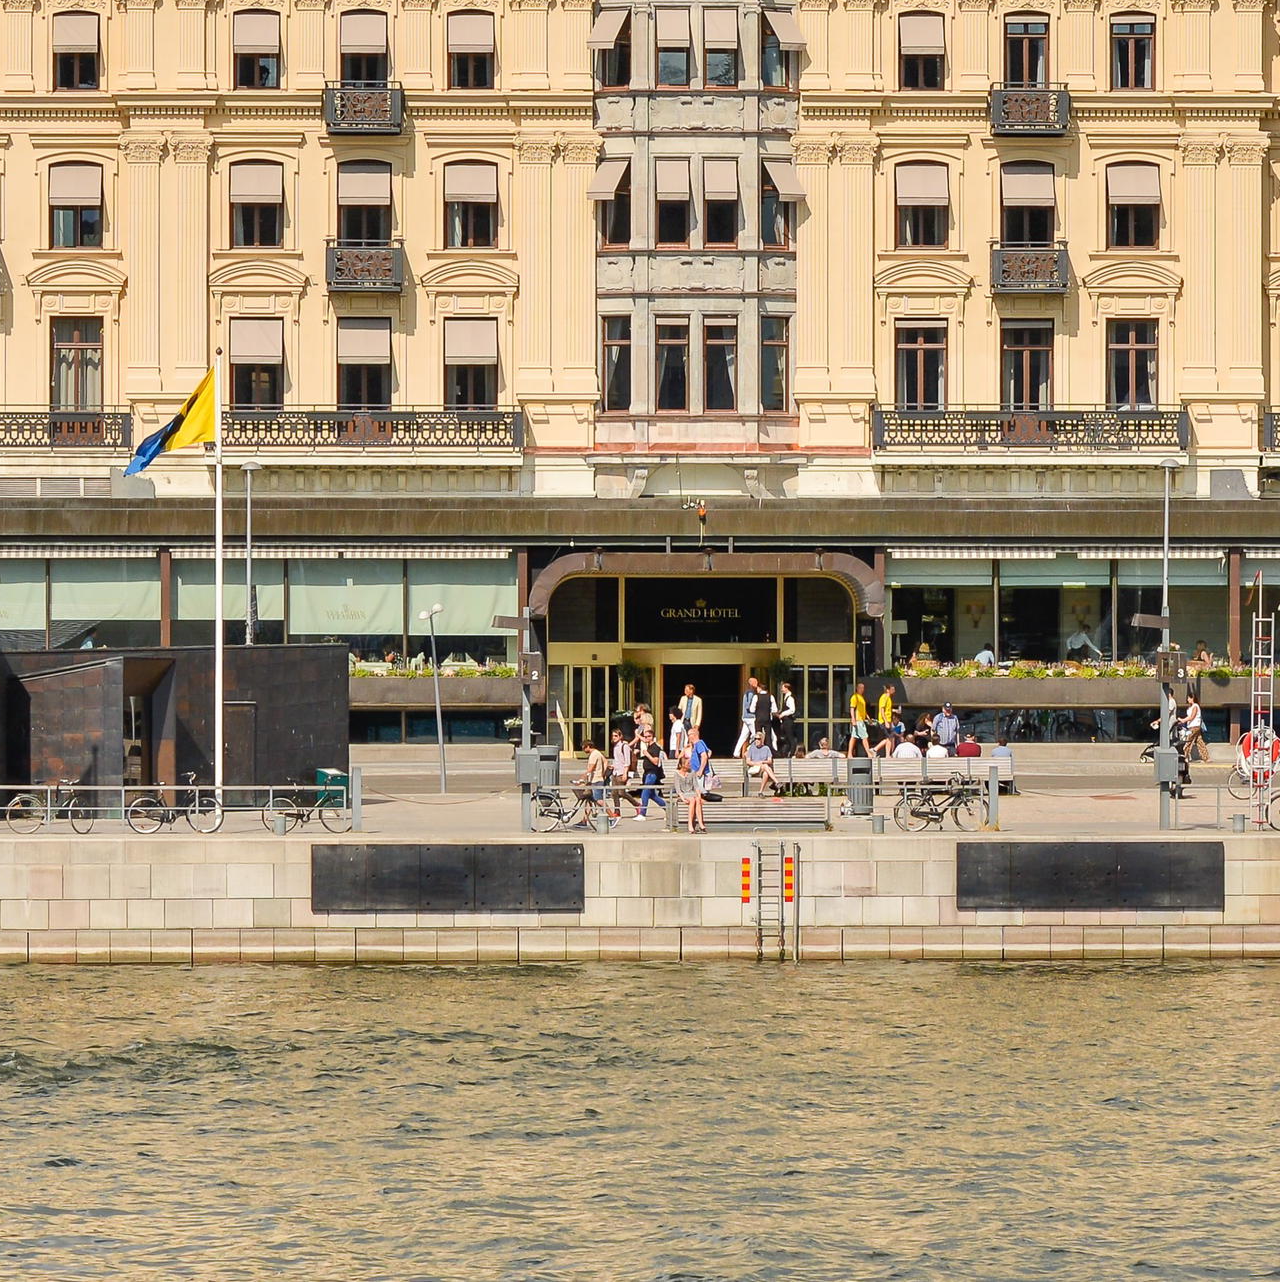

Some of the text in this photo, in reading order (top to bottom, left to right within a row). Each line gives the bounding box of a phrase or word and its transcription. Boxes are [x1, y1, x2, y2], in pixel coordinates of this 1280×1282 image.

[660, 607, 701, 618] GRAND
[531, 670, 539, 680] 2
[1177, 668, 1185, 678] 3
